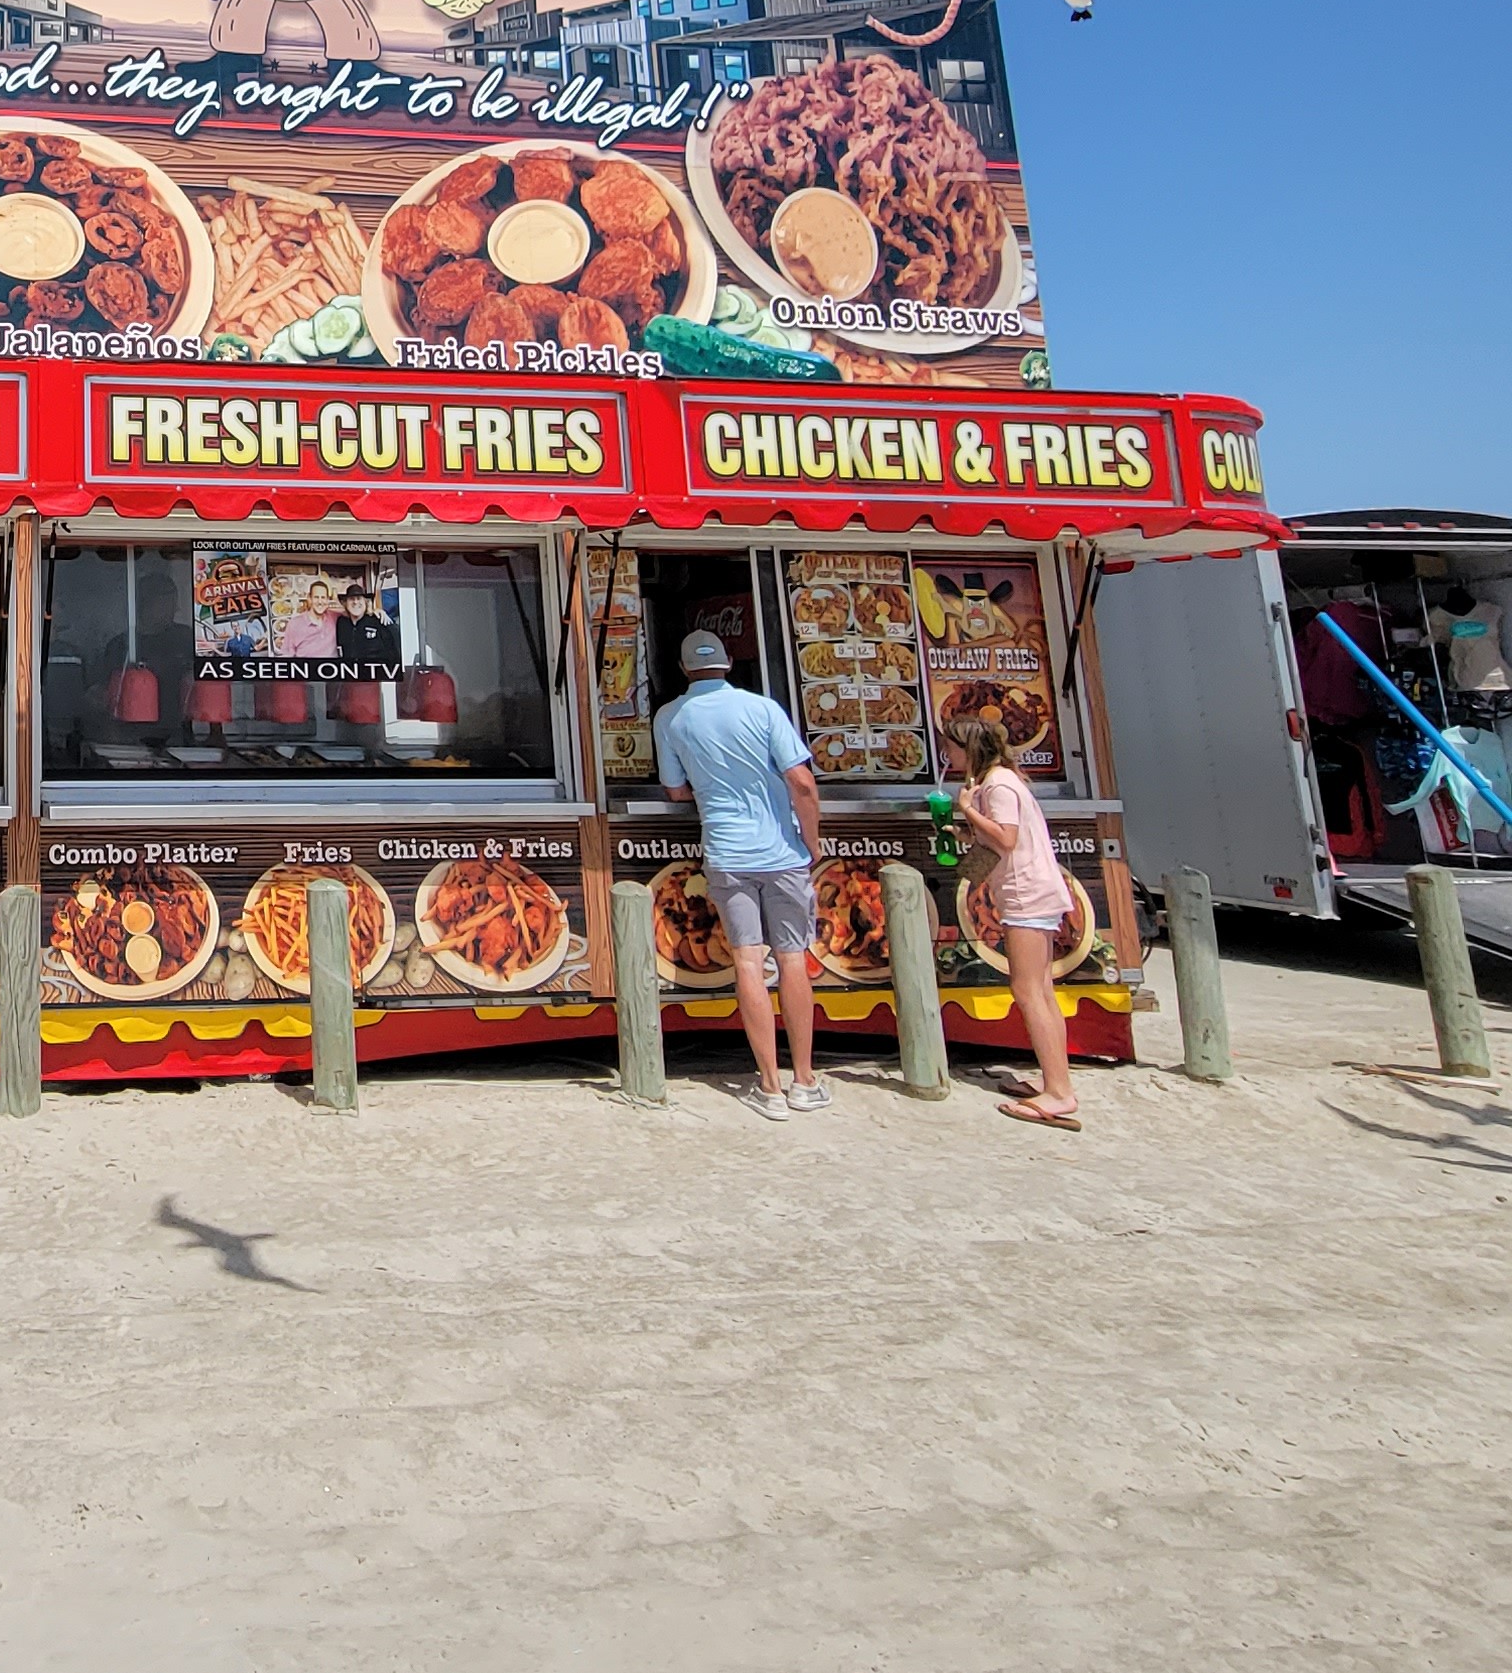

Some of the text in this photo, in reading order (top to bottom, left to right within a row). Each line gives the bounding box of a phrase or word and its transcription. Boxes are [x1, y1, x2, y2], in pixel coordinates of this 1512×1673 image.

[232, 60, 401, 132] ought
[406, 74, 465, 118] to
[471, 66, 520, 120] be
[770, 296, 1022, 336] Onion Straws
[393, 337, 663, 379] Fried Pickles
[109, 394, 606, 475] FRESH-CUT FRIES
[702, 411, 1154, 489] CHICKEN & FRIES
[192, 540, 396, 553] LOOK FOR OUTLAW FRIES FEATURED ON CARNIVAL EATS
[196, 578, 265, 606] CARNIVAL
[214, 593, 263, 615] EATS
[198, 661, 401, 680] AS SEEN ON TV
[928, 647, 1040, 671] OUTLAW FRIES
[48, 843, 239, 866] Combo Platter
[283, 842, 353, 864] Fries
[377, 837, 574, 861] Chicken & Fries
[617, 838, 703, 860] Outlaw
[818, 836, 905, 858] Nachos
